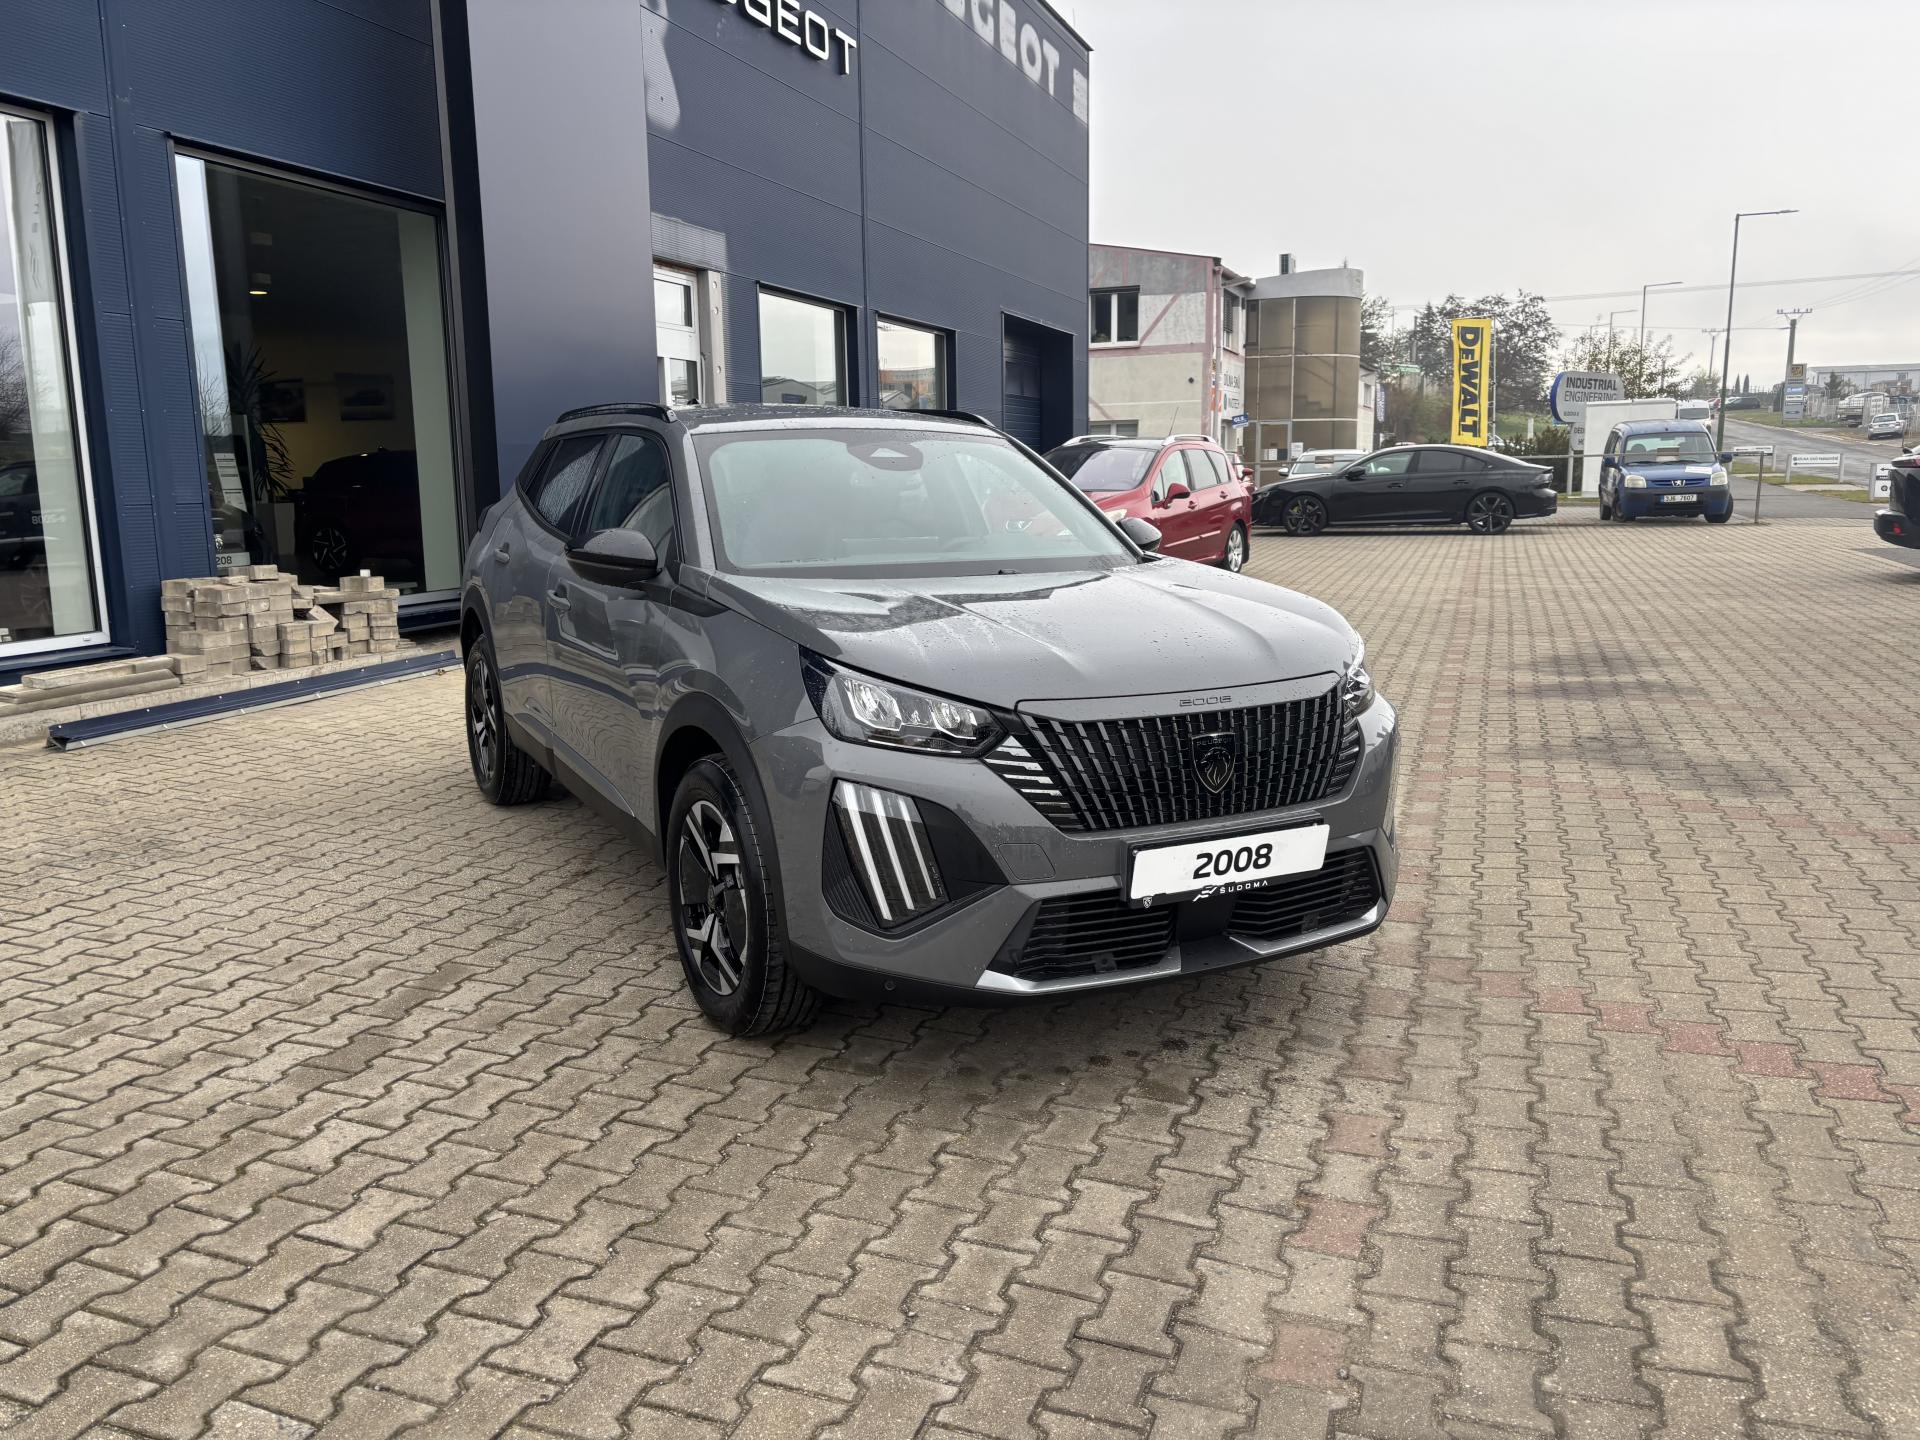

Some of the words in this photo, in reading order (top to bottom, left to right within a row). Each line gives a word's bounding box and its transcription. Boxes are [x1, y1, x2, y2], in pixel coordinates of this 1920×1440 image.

[726, 0, 857, 75] GEOT
[1565, 377, 1618, 391] INDUSTRIAL
[1193, 843, 1273, 880] 2008
[1219, 880, 1268, 894] SUDOMA
